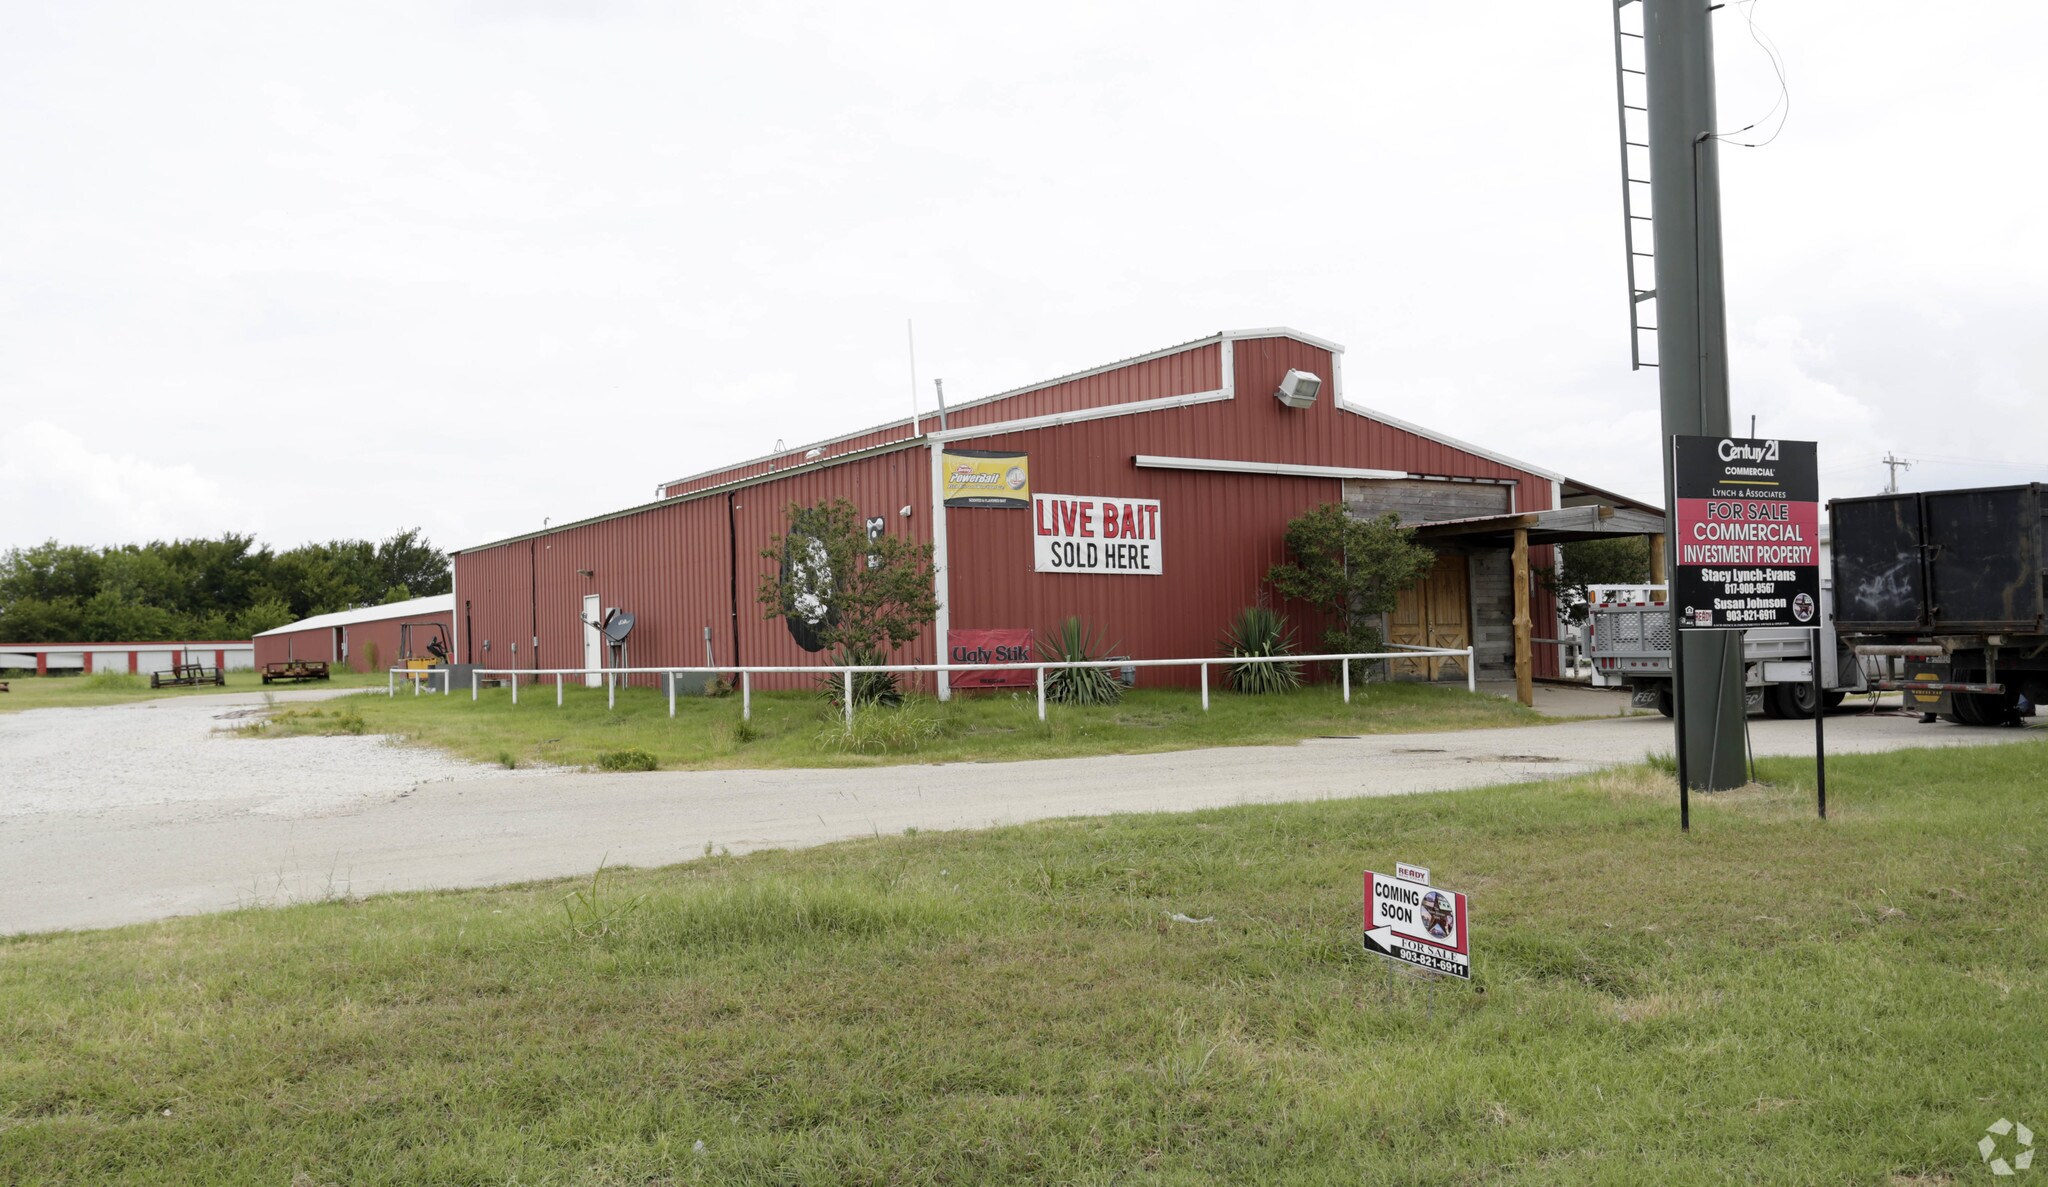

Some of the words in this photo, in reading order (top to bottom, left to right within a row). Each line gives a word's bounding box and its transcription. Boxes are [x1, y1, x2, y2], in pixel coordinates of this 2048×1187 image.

[1718, 439, 1766, 463] Century
[1765, 440, 1779, 461] 21
[949, 472, 1000, 484] PowerBait
[1725, 467, 1774, 477] COMMERCIAL
[1738, 489, 1744, 497] &
[1036, 499, 1094, 538] LIVE
[1103, 502, 1158, 540] BAIT
[1707, 502, 1744, 520] FOR
[1747, 503, 1788, 521] SALE
[1693, 522, 1803, 542] COMMERCIAL
[1051, 541, 1098, 568] SOLD
[1105, 543, 1150, 570] HERE
[1684, 544, 1754, 563] INVESTMENT
[1757, 545, 1812, 563] PROPERTY
[1701, 568, 1732, 583] Stacy
[1733, 568, 1796, 582] Lynch-Evans
[1724, 583, 1775, 594] 817-908-9567
[1714, 598, 1745, 610] Susan
[1746, 597, 1787, 609] Johnson
[1726, 609, 1776, 621] 903-821-6911
[952, 645, 992, 664] Ugly
[995, 645, 1029, 661] Stik
[1635, 692, 1656, 702] FEC
[1398, 867, 1426, 879] READY
[1375, 882, 1419, 906] COMING
[1381, 902, 1412, 924] SOON
[1402, 938, 1424, 953] FOR
[1428, 946, 1458, 962] SALE
[1400, 949, 1463, 975] 903-821-6911
